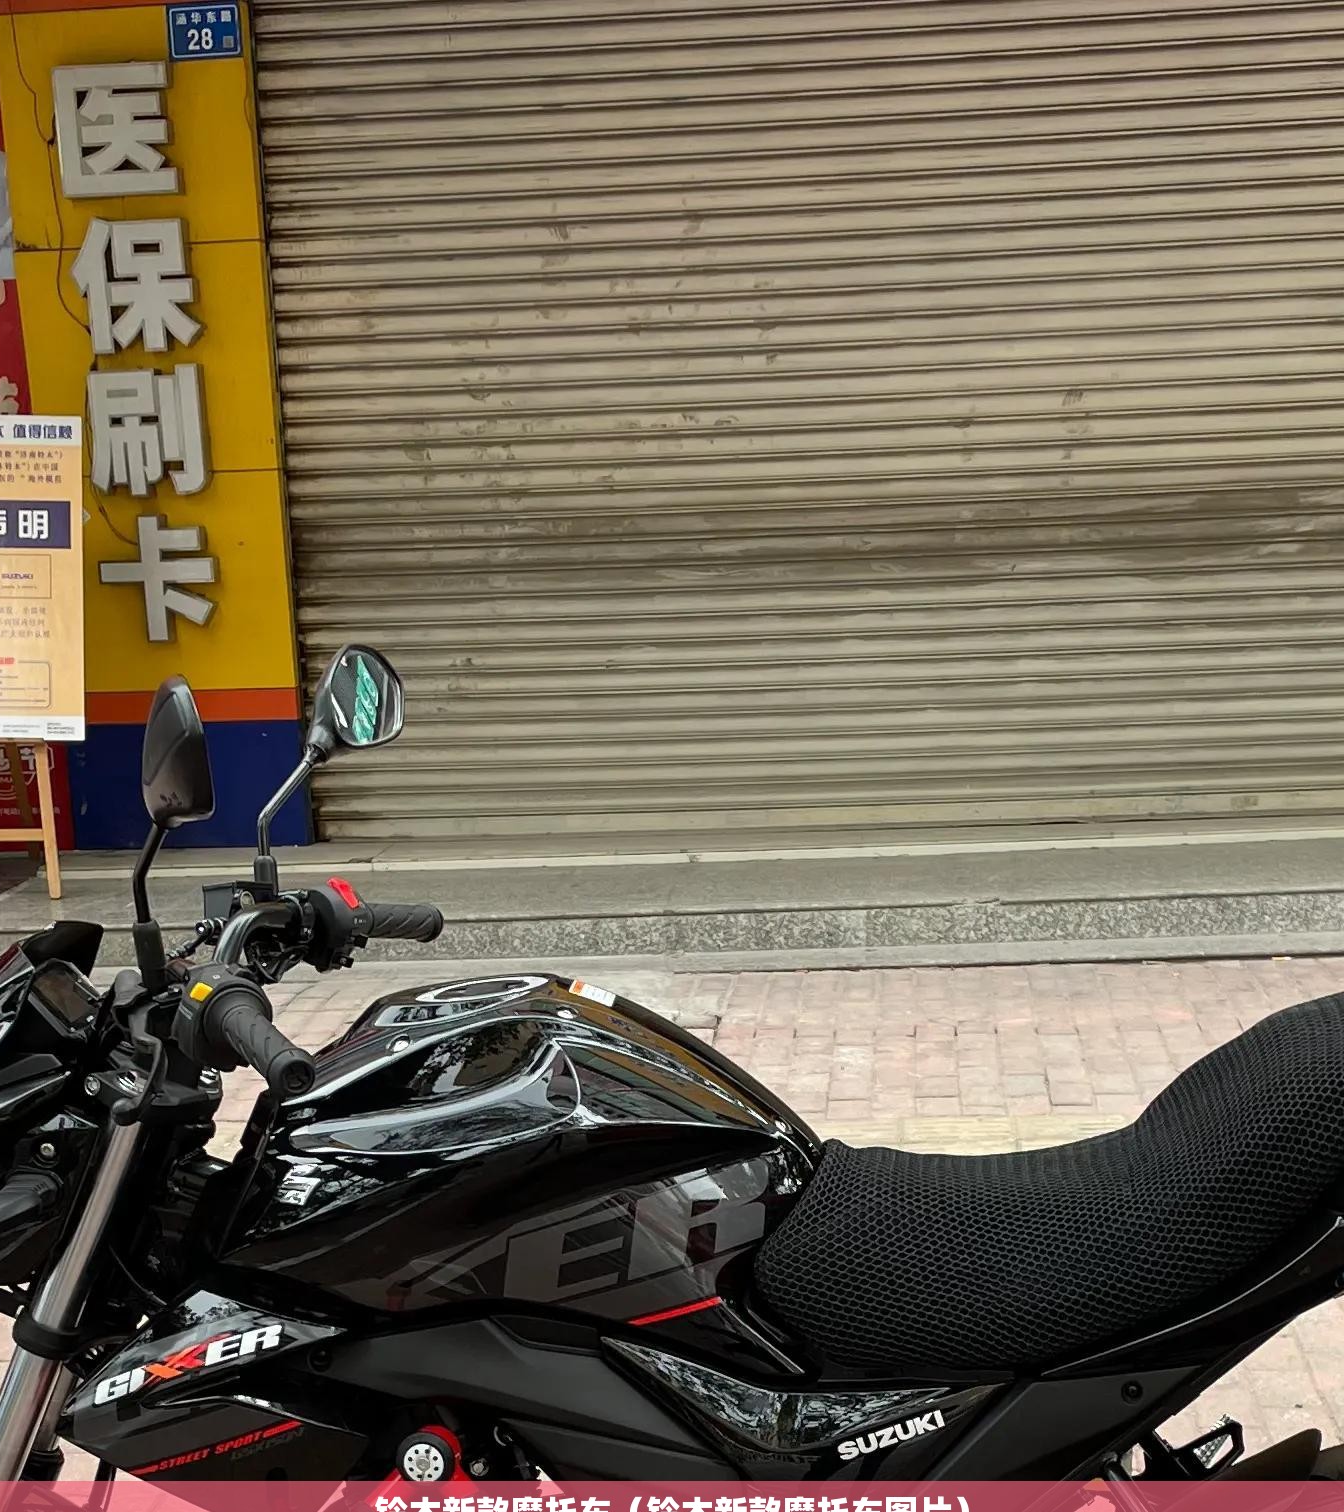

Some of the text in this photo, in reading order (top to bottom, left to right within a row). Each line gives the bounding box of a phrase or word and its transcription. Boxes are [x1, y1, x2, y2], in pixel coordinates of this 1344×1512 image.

[187, 28, 213, 50] 28
[51, 60, 219, 643] 医保刷卡
[12, 424, 73, 440] 值得信赖
[94, 1323, 285, 1405] GIXXER
[158, 1449, 209, 1471] STREET
[214, 1430, 263, 1456] SPORT
[836, 1409, 946, 1461] SUZUKI
